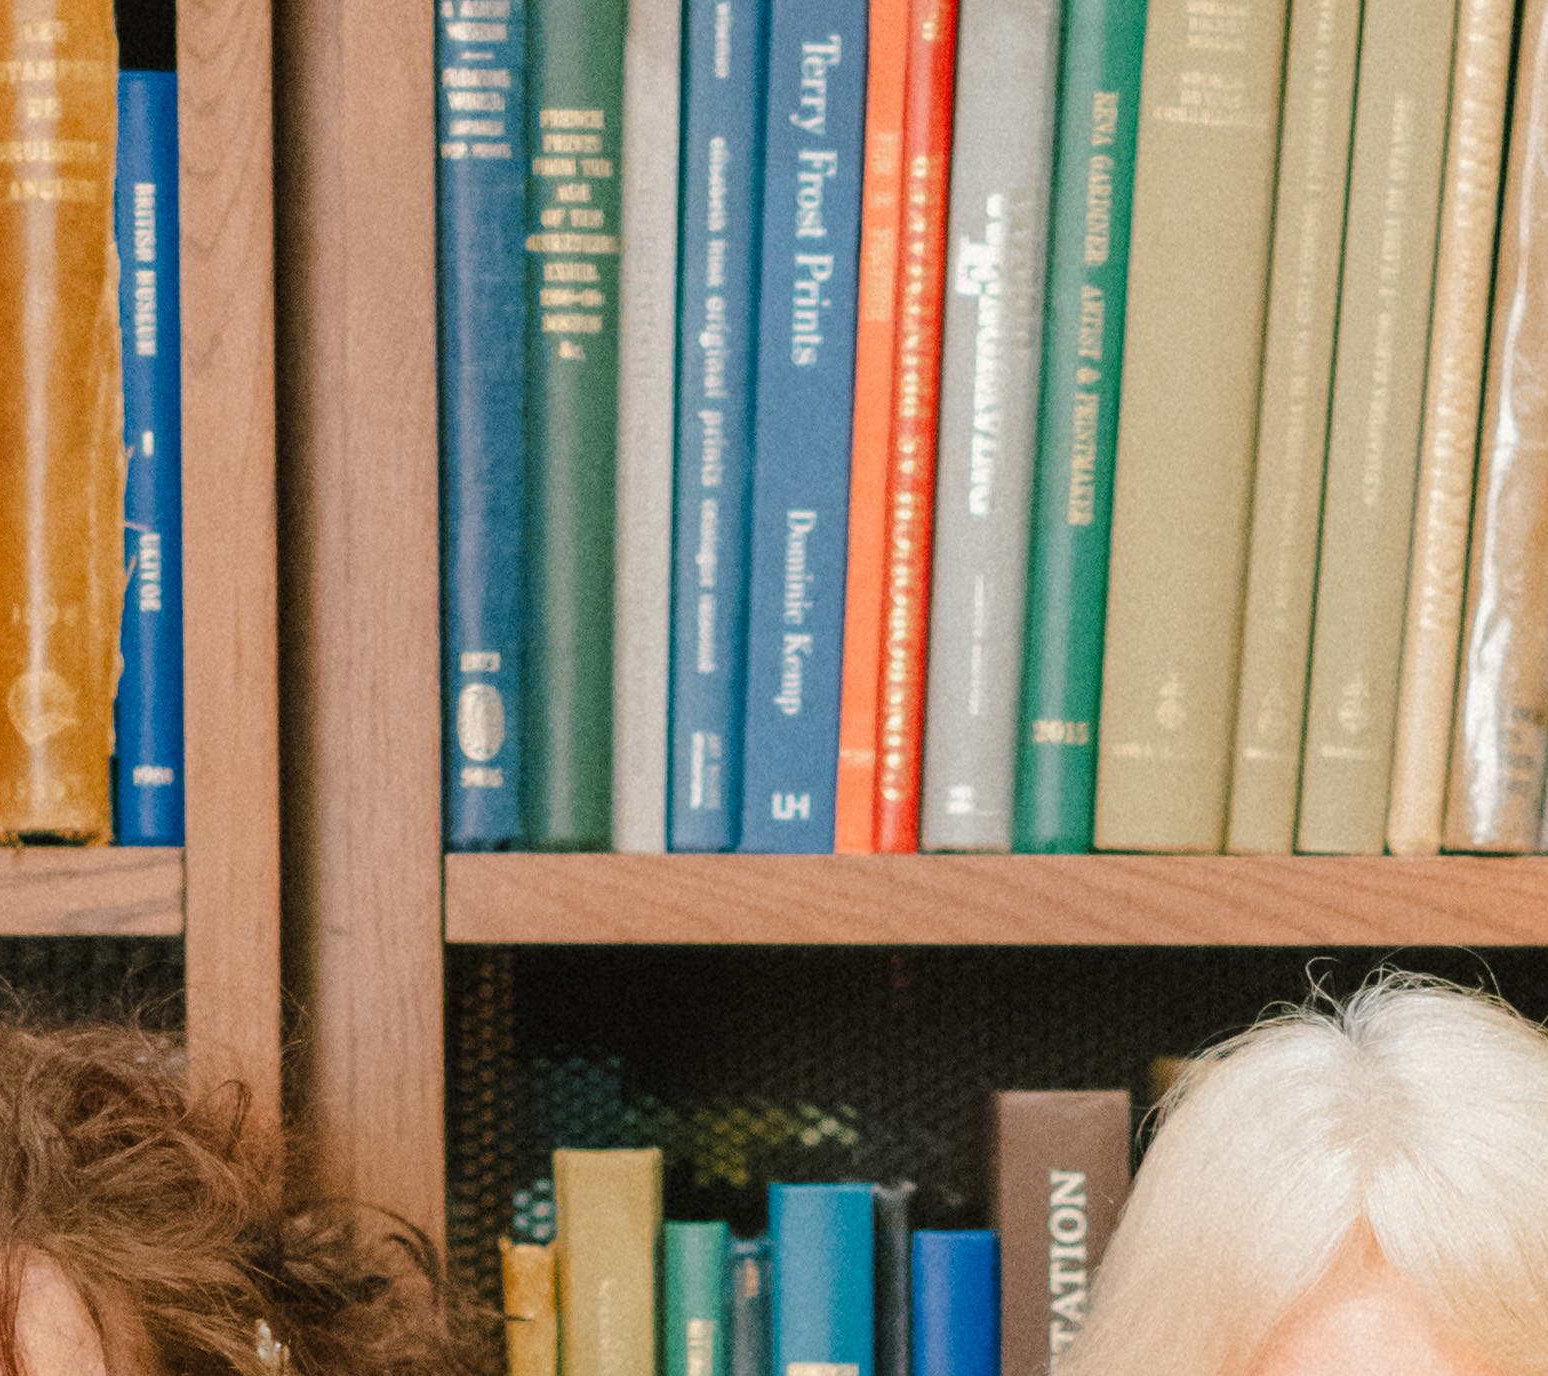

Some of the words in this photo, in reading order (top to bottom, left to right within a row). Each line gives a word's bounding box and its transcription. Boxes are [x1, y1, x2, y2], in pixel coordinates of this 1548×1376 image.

[790, 36, 841, 136] Terry
[135, 182, 155, 262] BRITISH
[796, 149, 838, 240] Frost
[135, 270, 156, 357] MUSEUM
[699, 296, 725, 399] original
[792, 253, 834, 367] Prints
[1079, 285, 1106, 361] ARTIST
[698, 410, 724, 488] prints
[1066, 393, 1100, 525] PRINTMAKER
[784, 509, 817, 624] Dominic
[773, 633, 813, 716] Kemp
